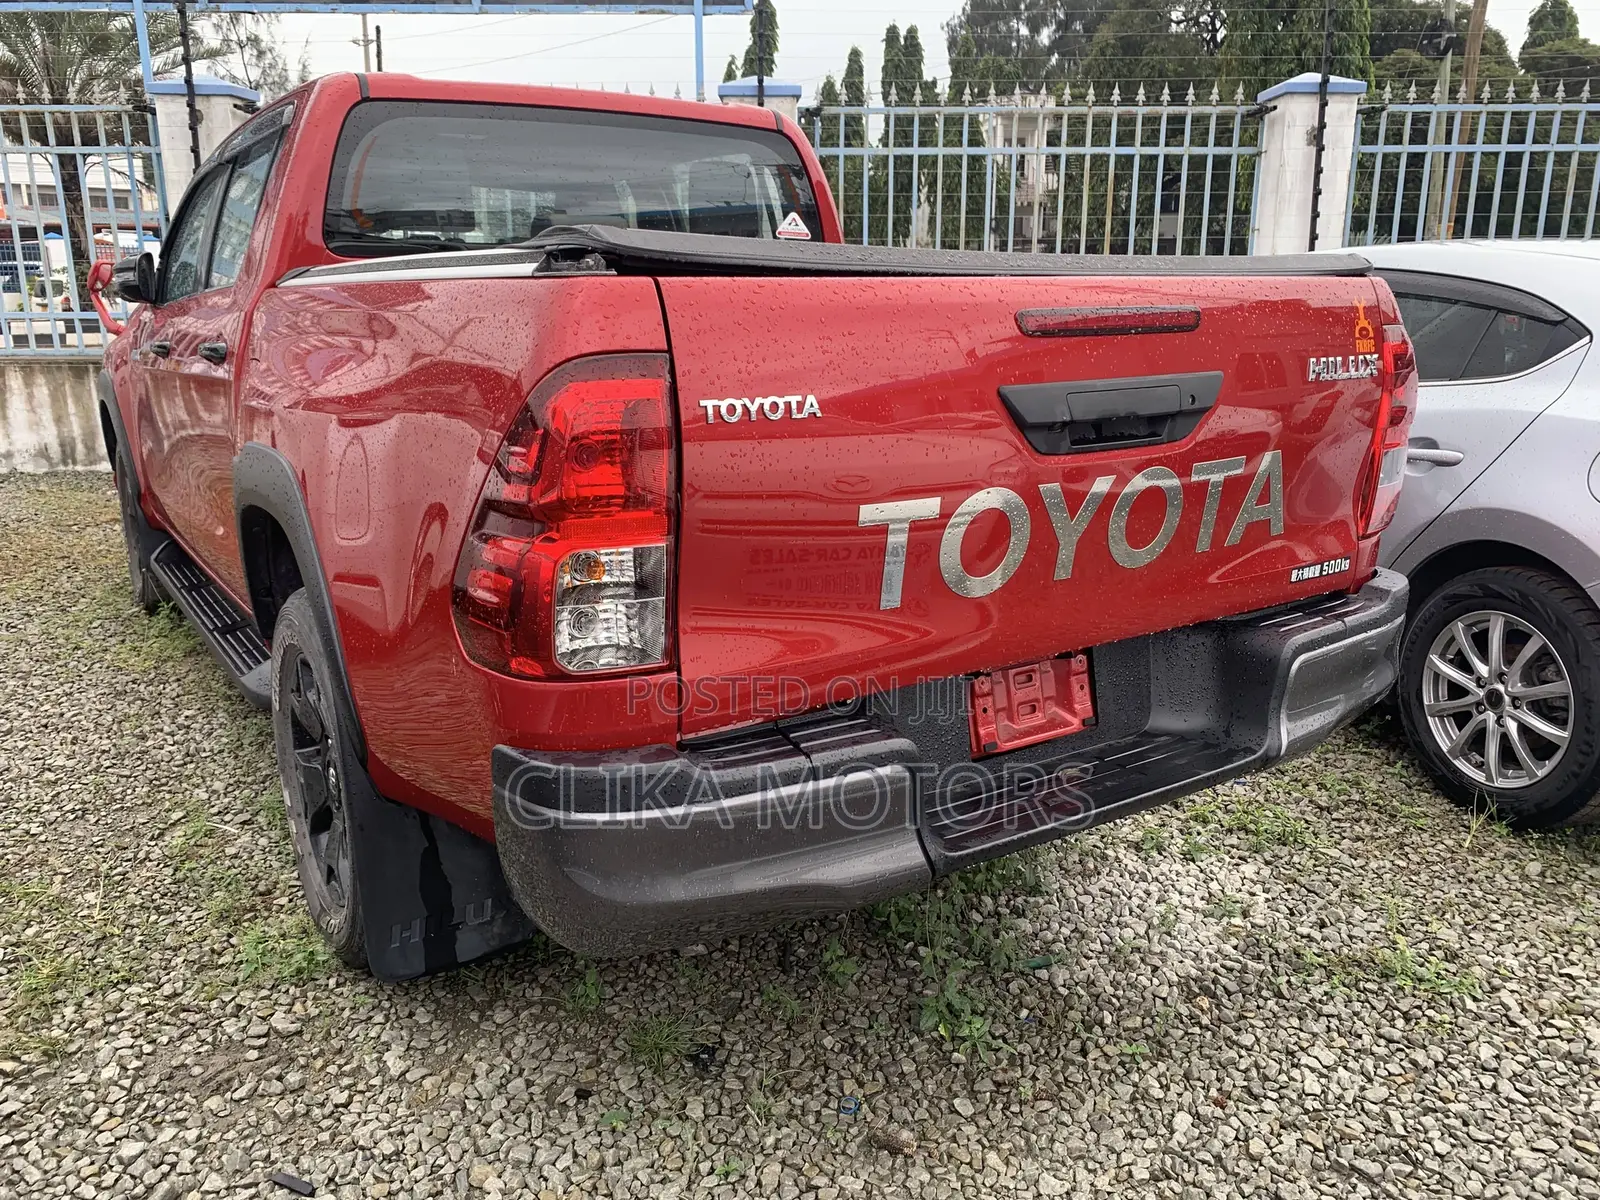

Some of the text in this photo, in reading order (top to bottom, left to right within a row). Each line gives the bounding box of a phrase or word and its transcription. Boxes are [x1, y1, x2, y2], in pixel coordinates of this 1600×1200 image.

[1308, 354, 1379, 381] HILUX
[699, 394, 822, 423] TOYOTA
[858, 450, 1285, 610] TOYOTA
